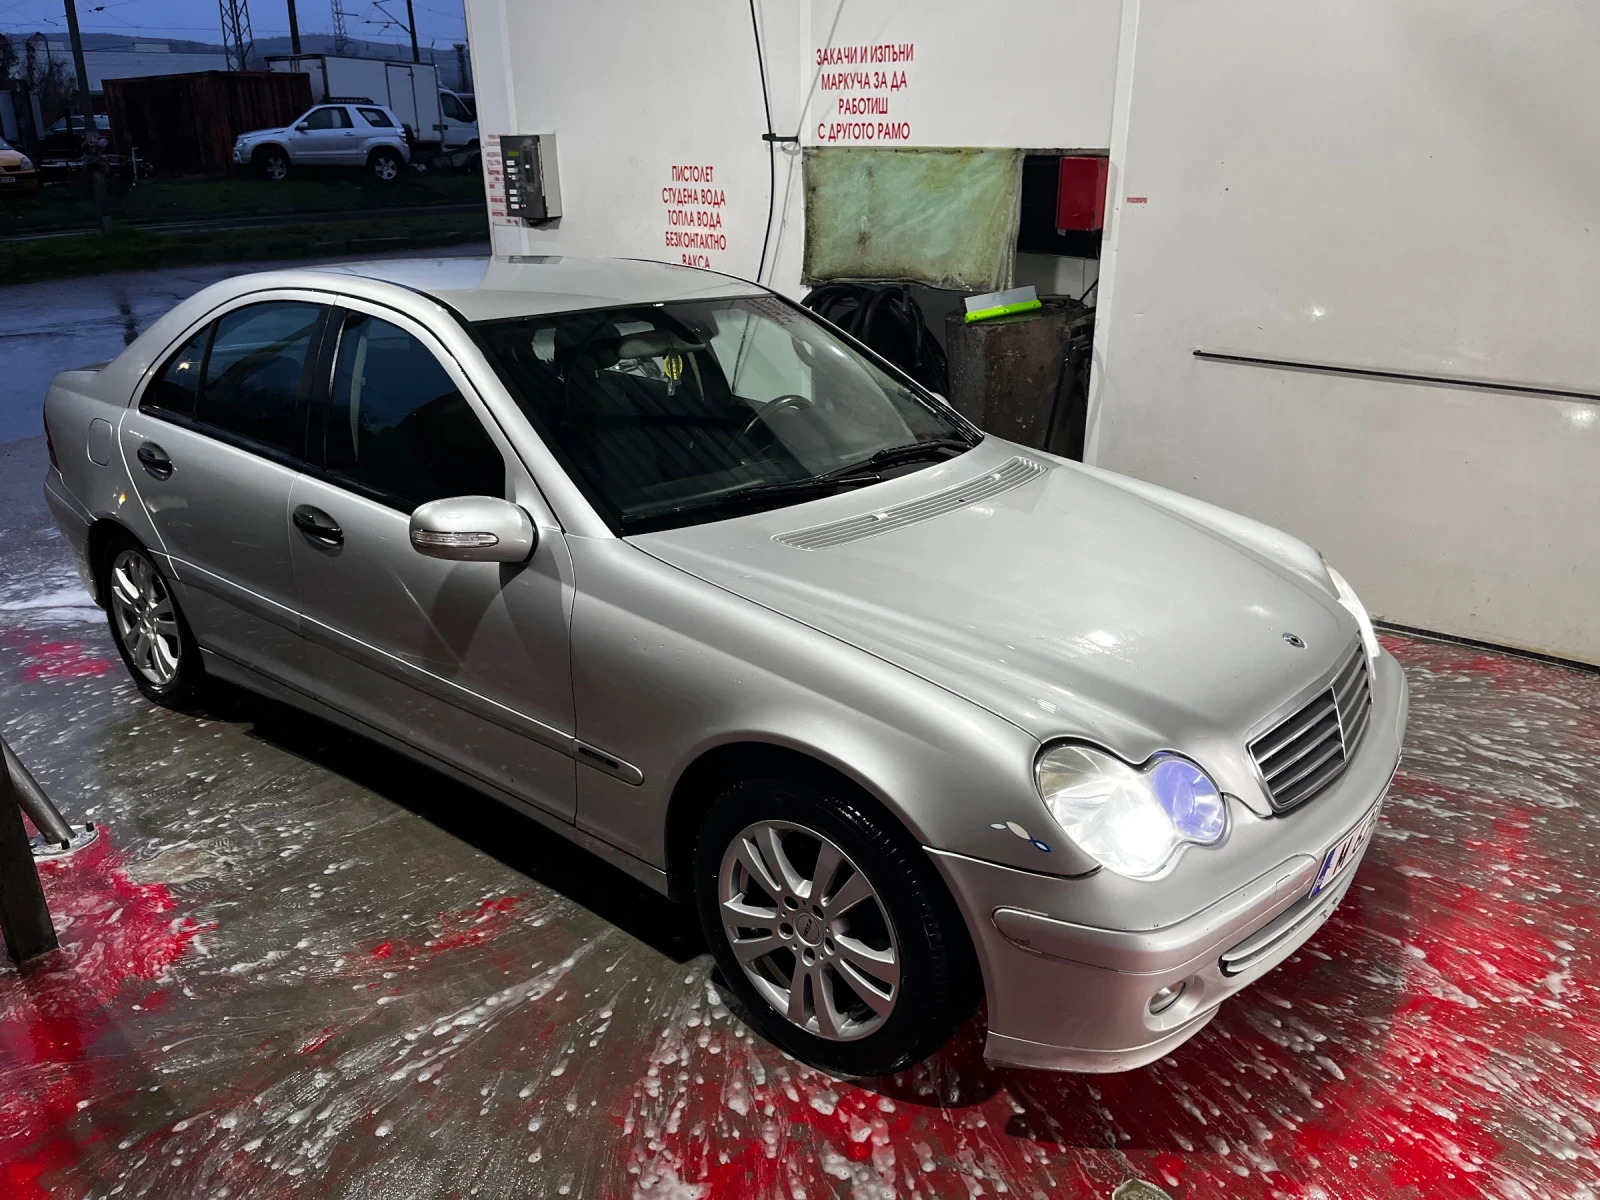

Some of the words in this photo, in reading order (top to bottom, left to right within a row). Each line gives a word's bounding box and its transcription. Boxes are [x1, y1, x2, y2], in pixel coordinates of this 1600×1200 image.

[816, 47, 858, 65] ЗАКАЧИ
[860, 46, 868, 63] И
[870, 44, 914, 62] ИЗПЪНИ
[821, 72, 871, 90] МАРКУЧА
[873, 71, 888, 89] ЗА
[890, 71, 908, 92] ДА
[838, 97, 888, 115] РАБОТИШ
[818, 123, 826, 140] С
[828, 123, 875, 142] ДРУГОТО
[877, 122, 911, 140] РАМО
[672, 165, 714, 182] ПИСТОЛЕТ
[662, 187, 699, 206] СТУДЕНА
[701, 189, 726, 208] ВОДА
[668, 210, 695, 226] ТОПЛА
[697, 211, 722, 230] ВОДА
[665, 231, 727, 251] БЕЗКОНТАКТНО
